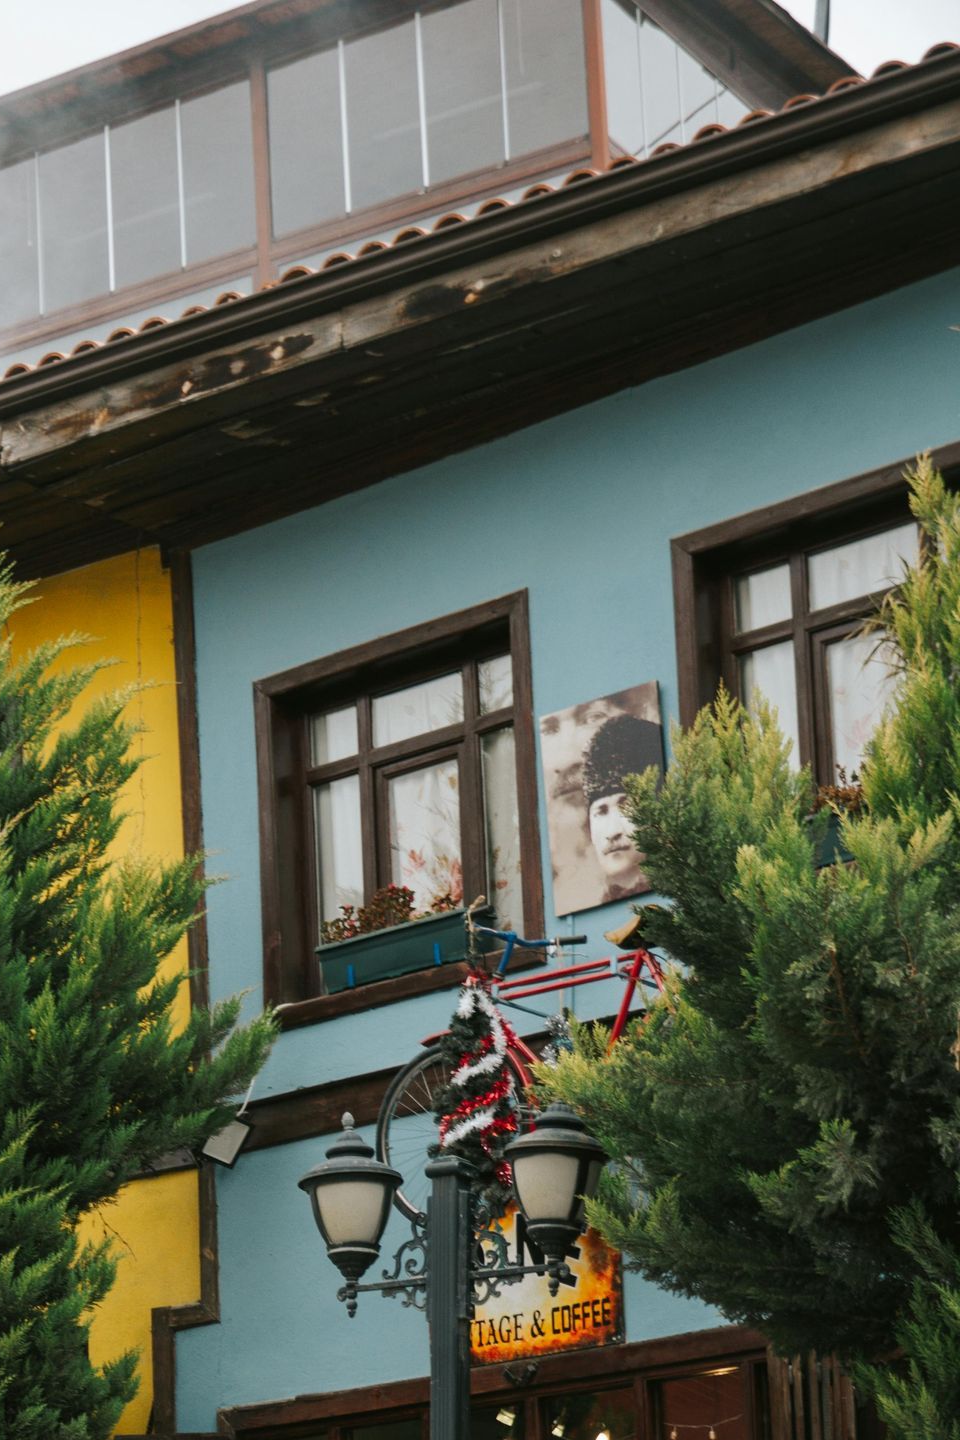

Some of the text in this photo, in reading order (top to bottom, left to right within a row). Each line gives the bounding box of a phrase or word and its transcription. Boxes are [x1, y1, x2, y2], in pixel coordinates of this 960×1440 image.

[470, 1297, 611, 1348] TAGE & COFFEE
